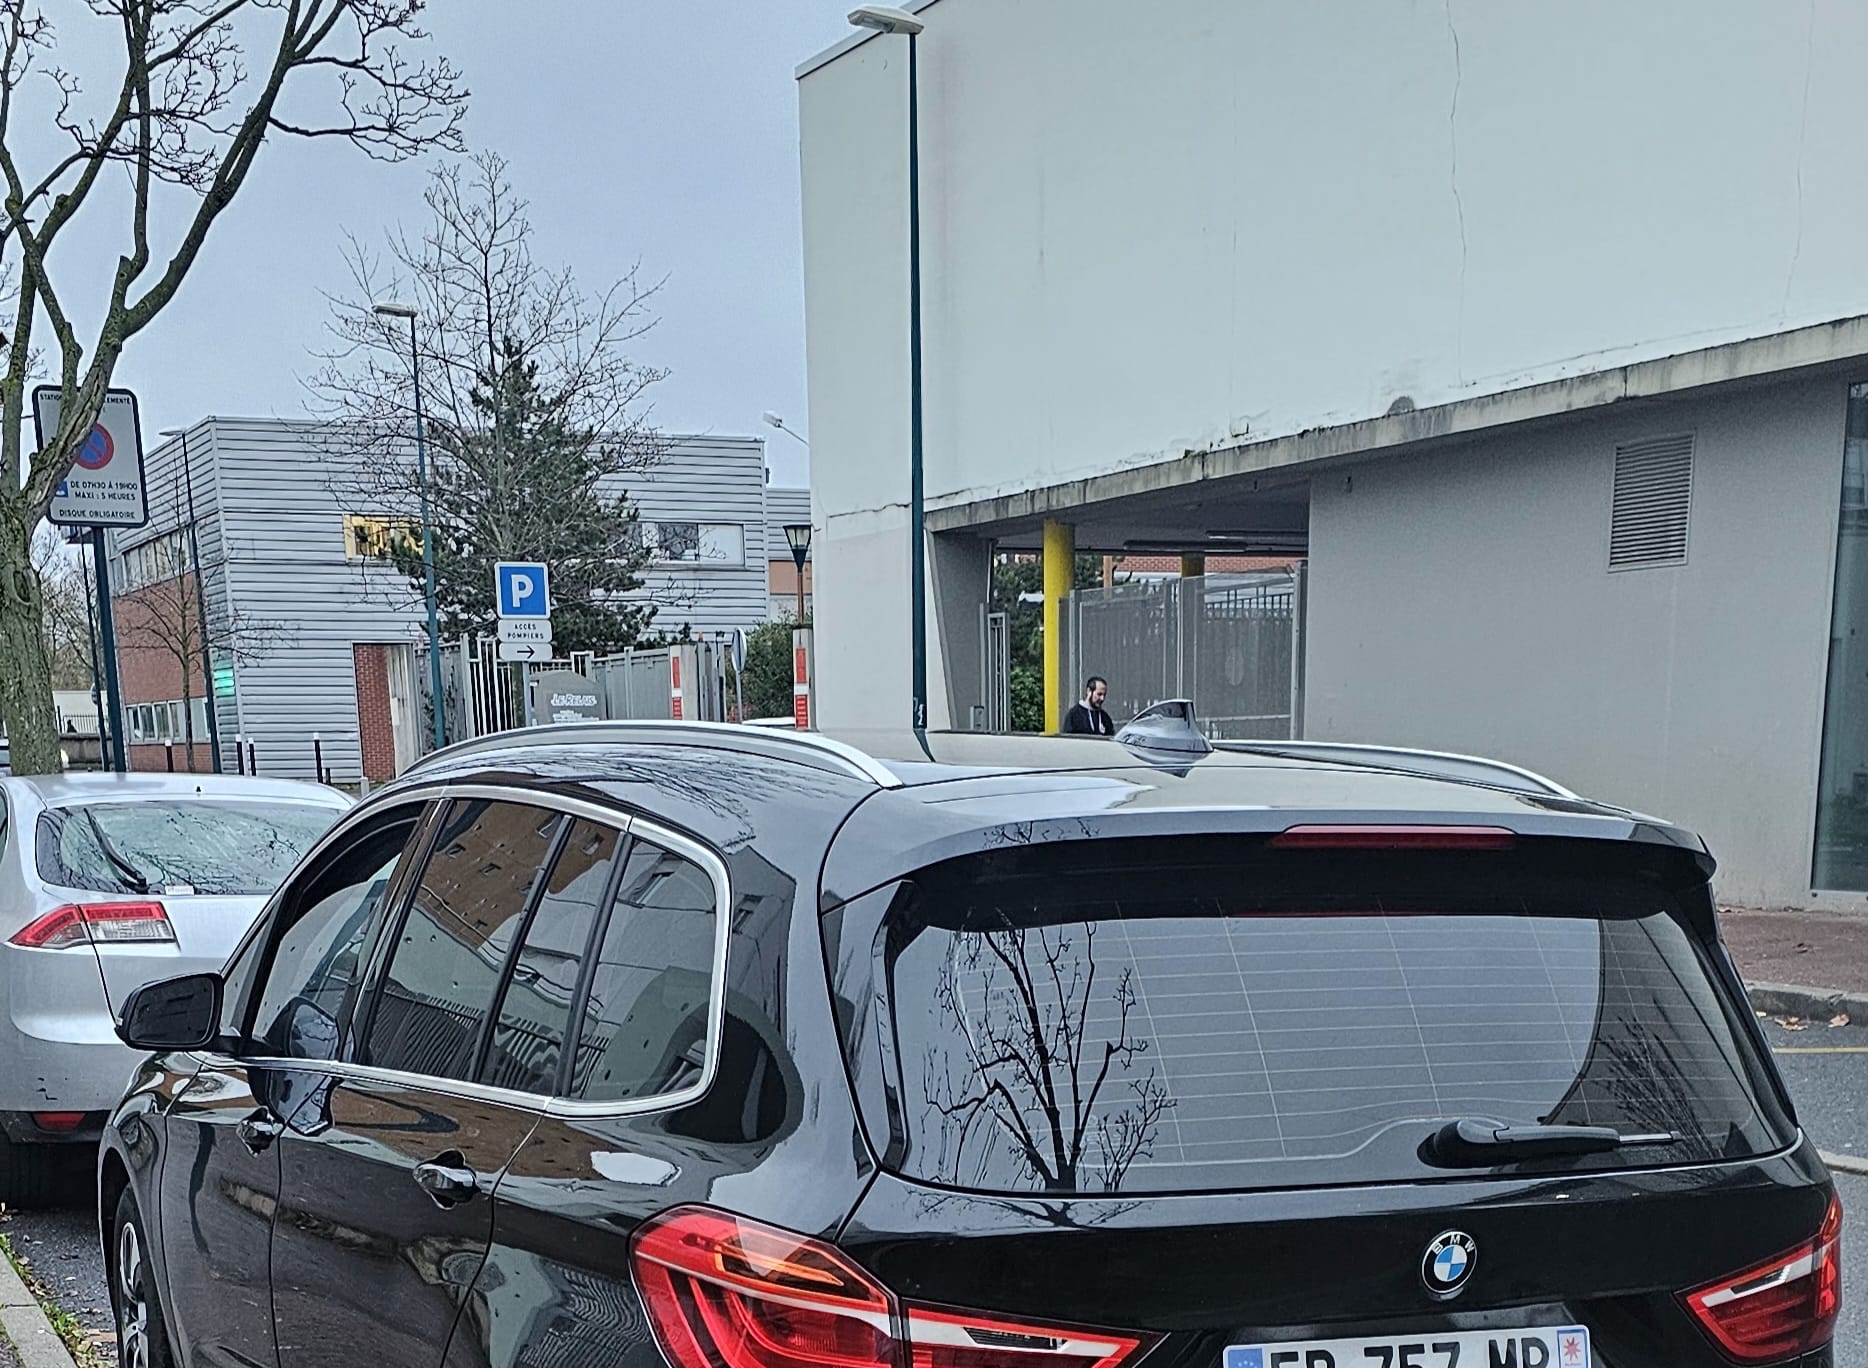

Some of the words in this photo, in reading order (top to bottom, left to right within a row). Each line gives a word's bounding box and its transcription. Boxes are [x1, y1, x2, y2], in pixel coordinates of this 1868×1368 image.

[70, 480, 80, 489] DE
[82, 481, 106, 490] 07H30
[115, 482, 138, 491] 19H00
[75, 491, 95, 499] MAXI
[108, 493, 136, 501] HEURES
[59, 509, 86, 518] DISQUE
[89, 510, 136, 519] OBLIGATOIRE
[511, 574, 534, 608] P
[507, 632, 544, 640] POMPIERS
[1431, 1233, 1475, 1255] BMW
